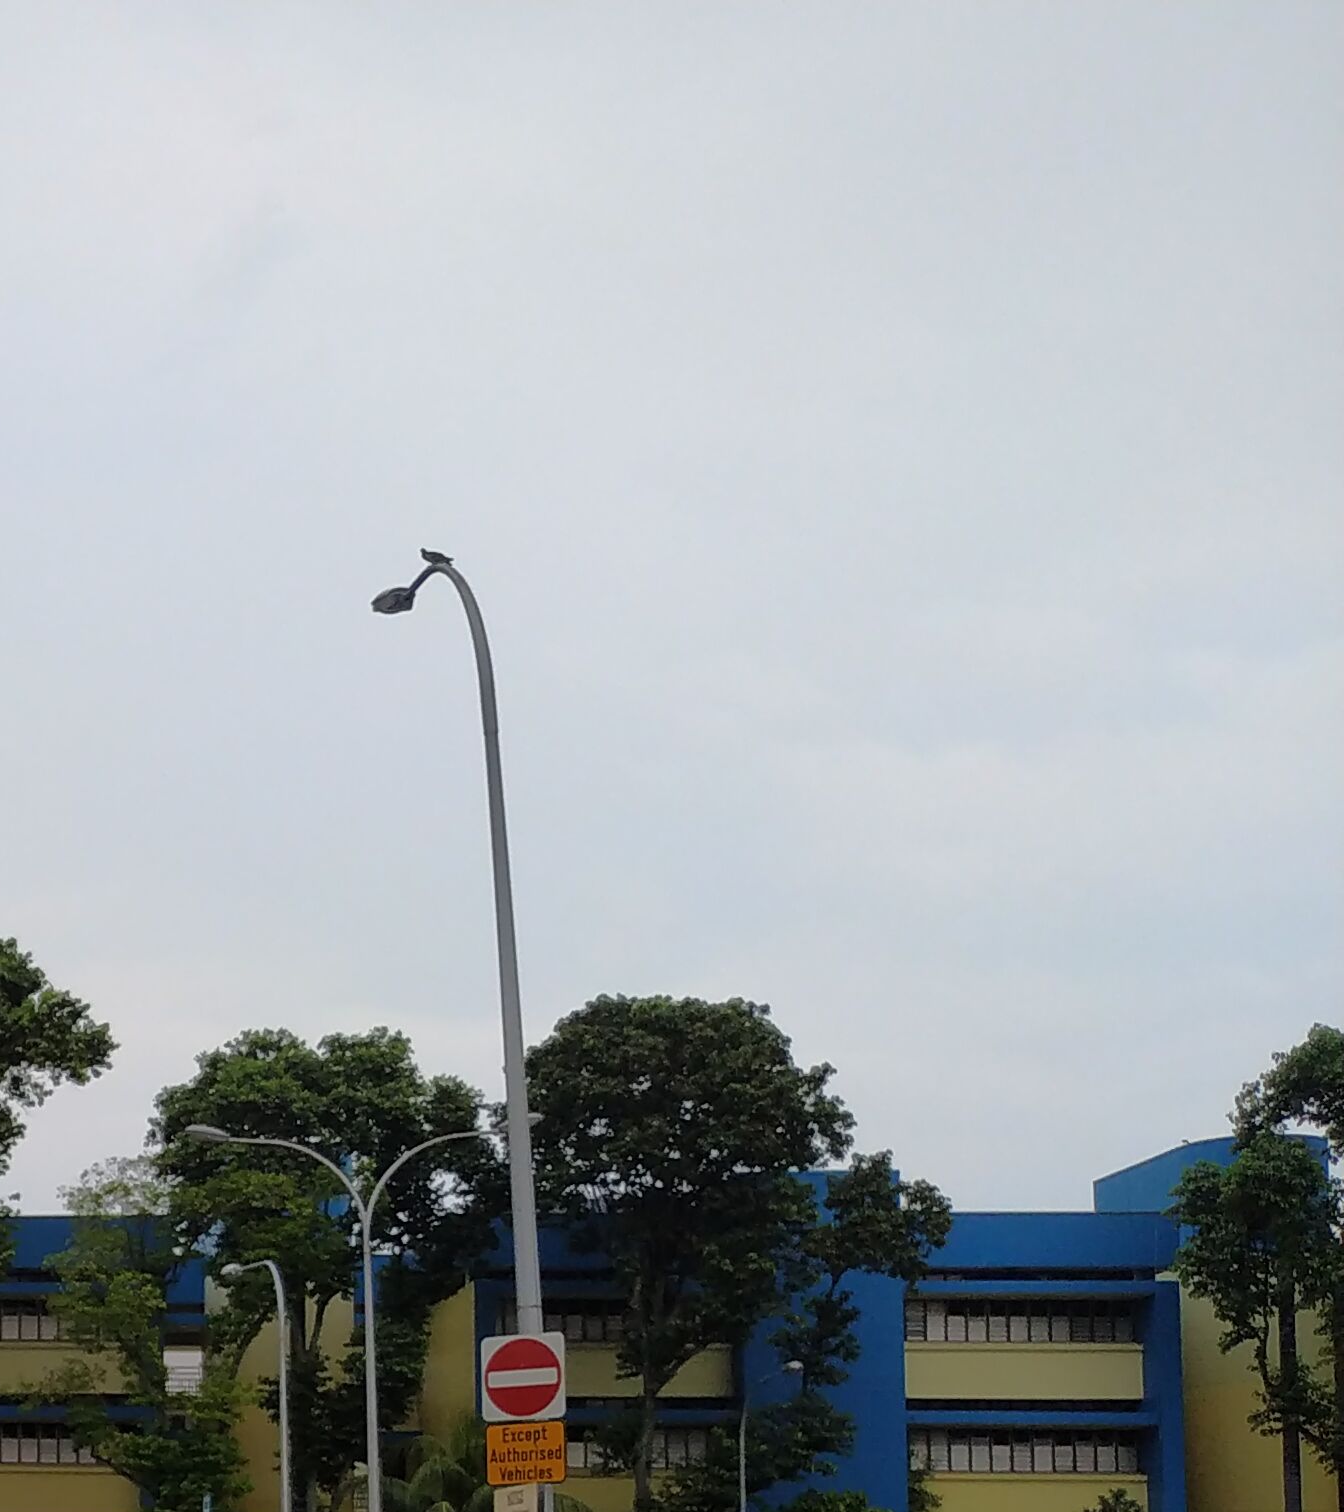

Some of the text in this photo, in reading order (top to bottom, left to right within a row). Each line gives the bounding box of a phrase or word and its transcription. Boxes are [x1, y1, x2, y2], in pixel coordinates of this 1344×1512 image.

[502, 1425, 548, 1444] Except
[489, 1443, 562, 1464] Authorised
[499, 1465, 554, 1482] Vehicles
